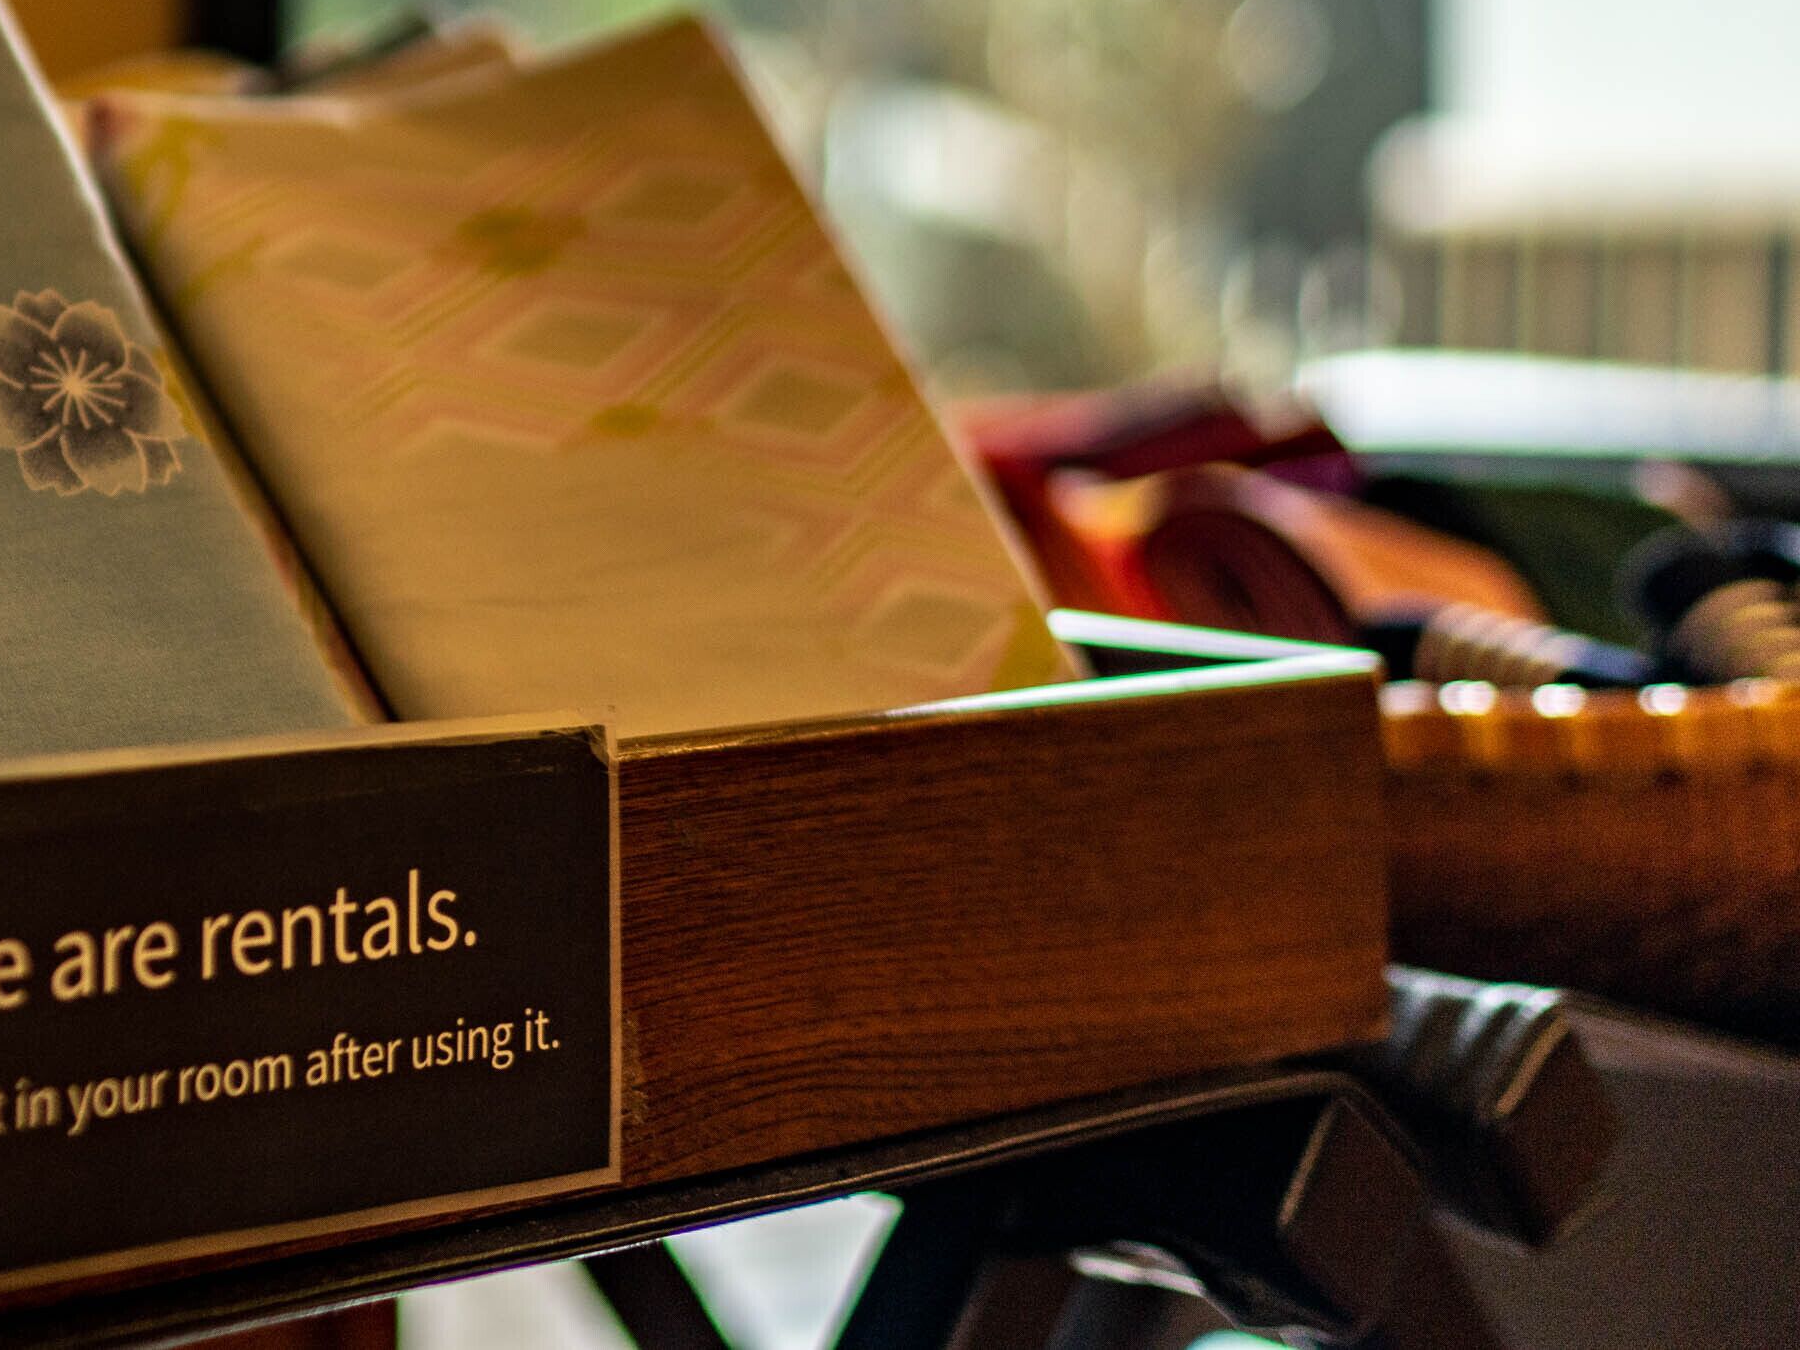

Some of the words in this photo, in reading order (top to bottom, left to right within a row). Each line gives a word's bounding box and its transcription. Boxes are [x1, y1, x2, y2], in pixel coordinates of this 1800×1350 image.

[50, 920, 179, 1003] are
[200, 867, 478, 982] rentals.
[14, 1078, 61, 1131] in
[67, 1067, 169, 1137] your
[177, 1054, 293, 1105] room
[304, 1030, 403, 1087] after
[410, 1019, 516, 1072] using
[523, 1008, 561, 1053] it.
